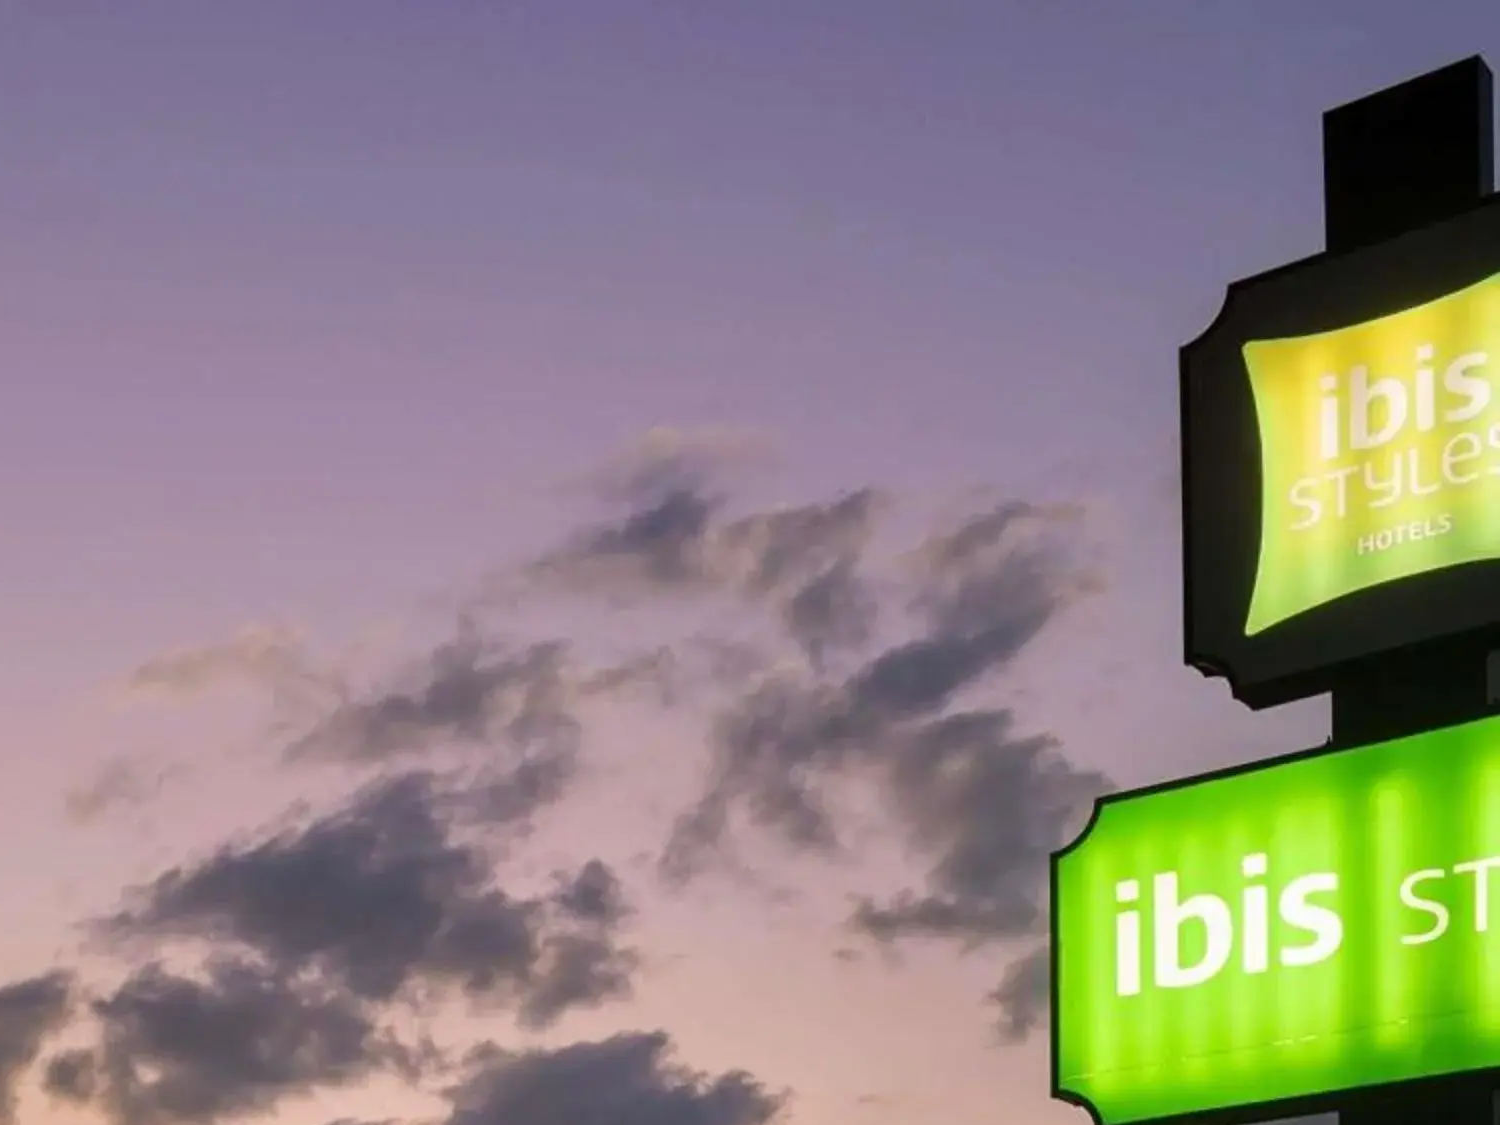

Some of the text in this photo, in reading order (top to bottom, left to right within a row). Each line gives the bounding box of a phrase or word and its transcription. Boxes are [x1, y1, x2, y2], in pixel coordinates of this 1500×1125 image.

[1318, 343, 1492, 461] ibis
[1357, 513, 1453, 556] HOTELS
[1115, 852, 1344, 997] ibis
